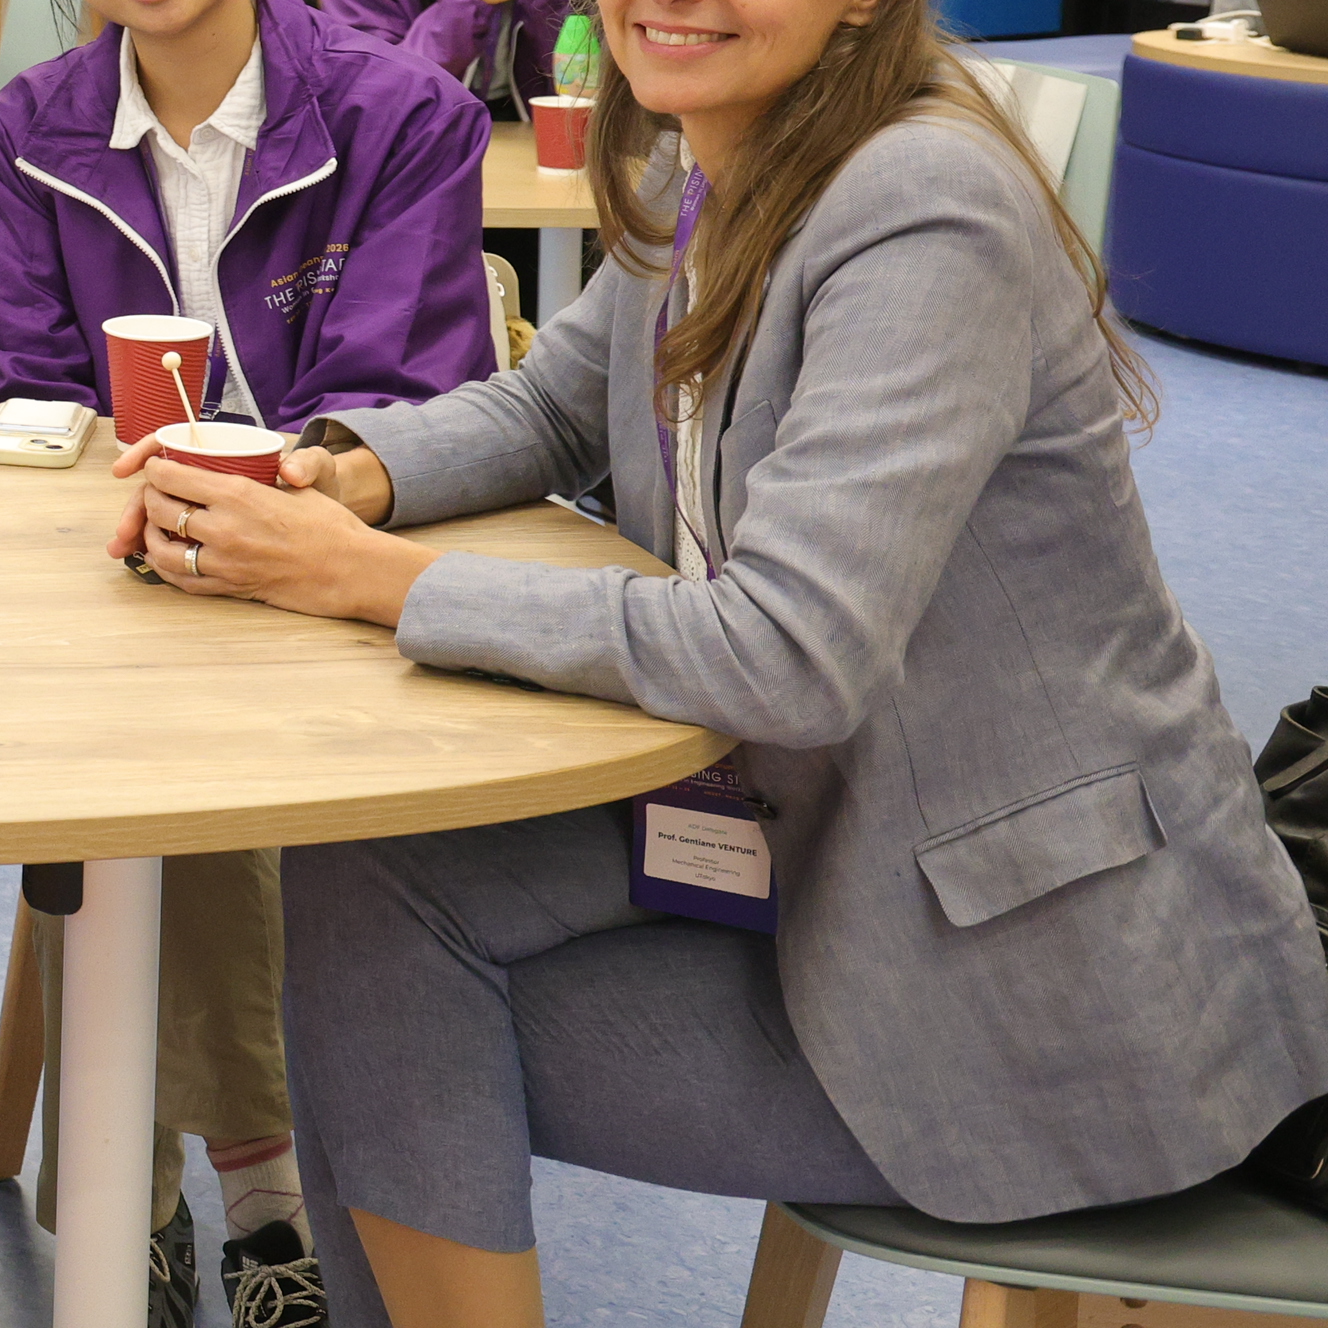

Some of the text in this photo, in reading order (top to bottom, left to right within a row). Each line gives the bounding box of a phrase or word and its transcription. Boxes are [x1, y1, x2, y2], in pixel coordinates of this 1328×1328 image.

[680, 197, 693, 217] THE
[264, 288, 295, 310] THE
[658, 832, 758, 856] Prof. Gentiane VENTURE
[672, 858, 741, 877] Mechanical Engineering
